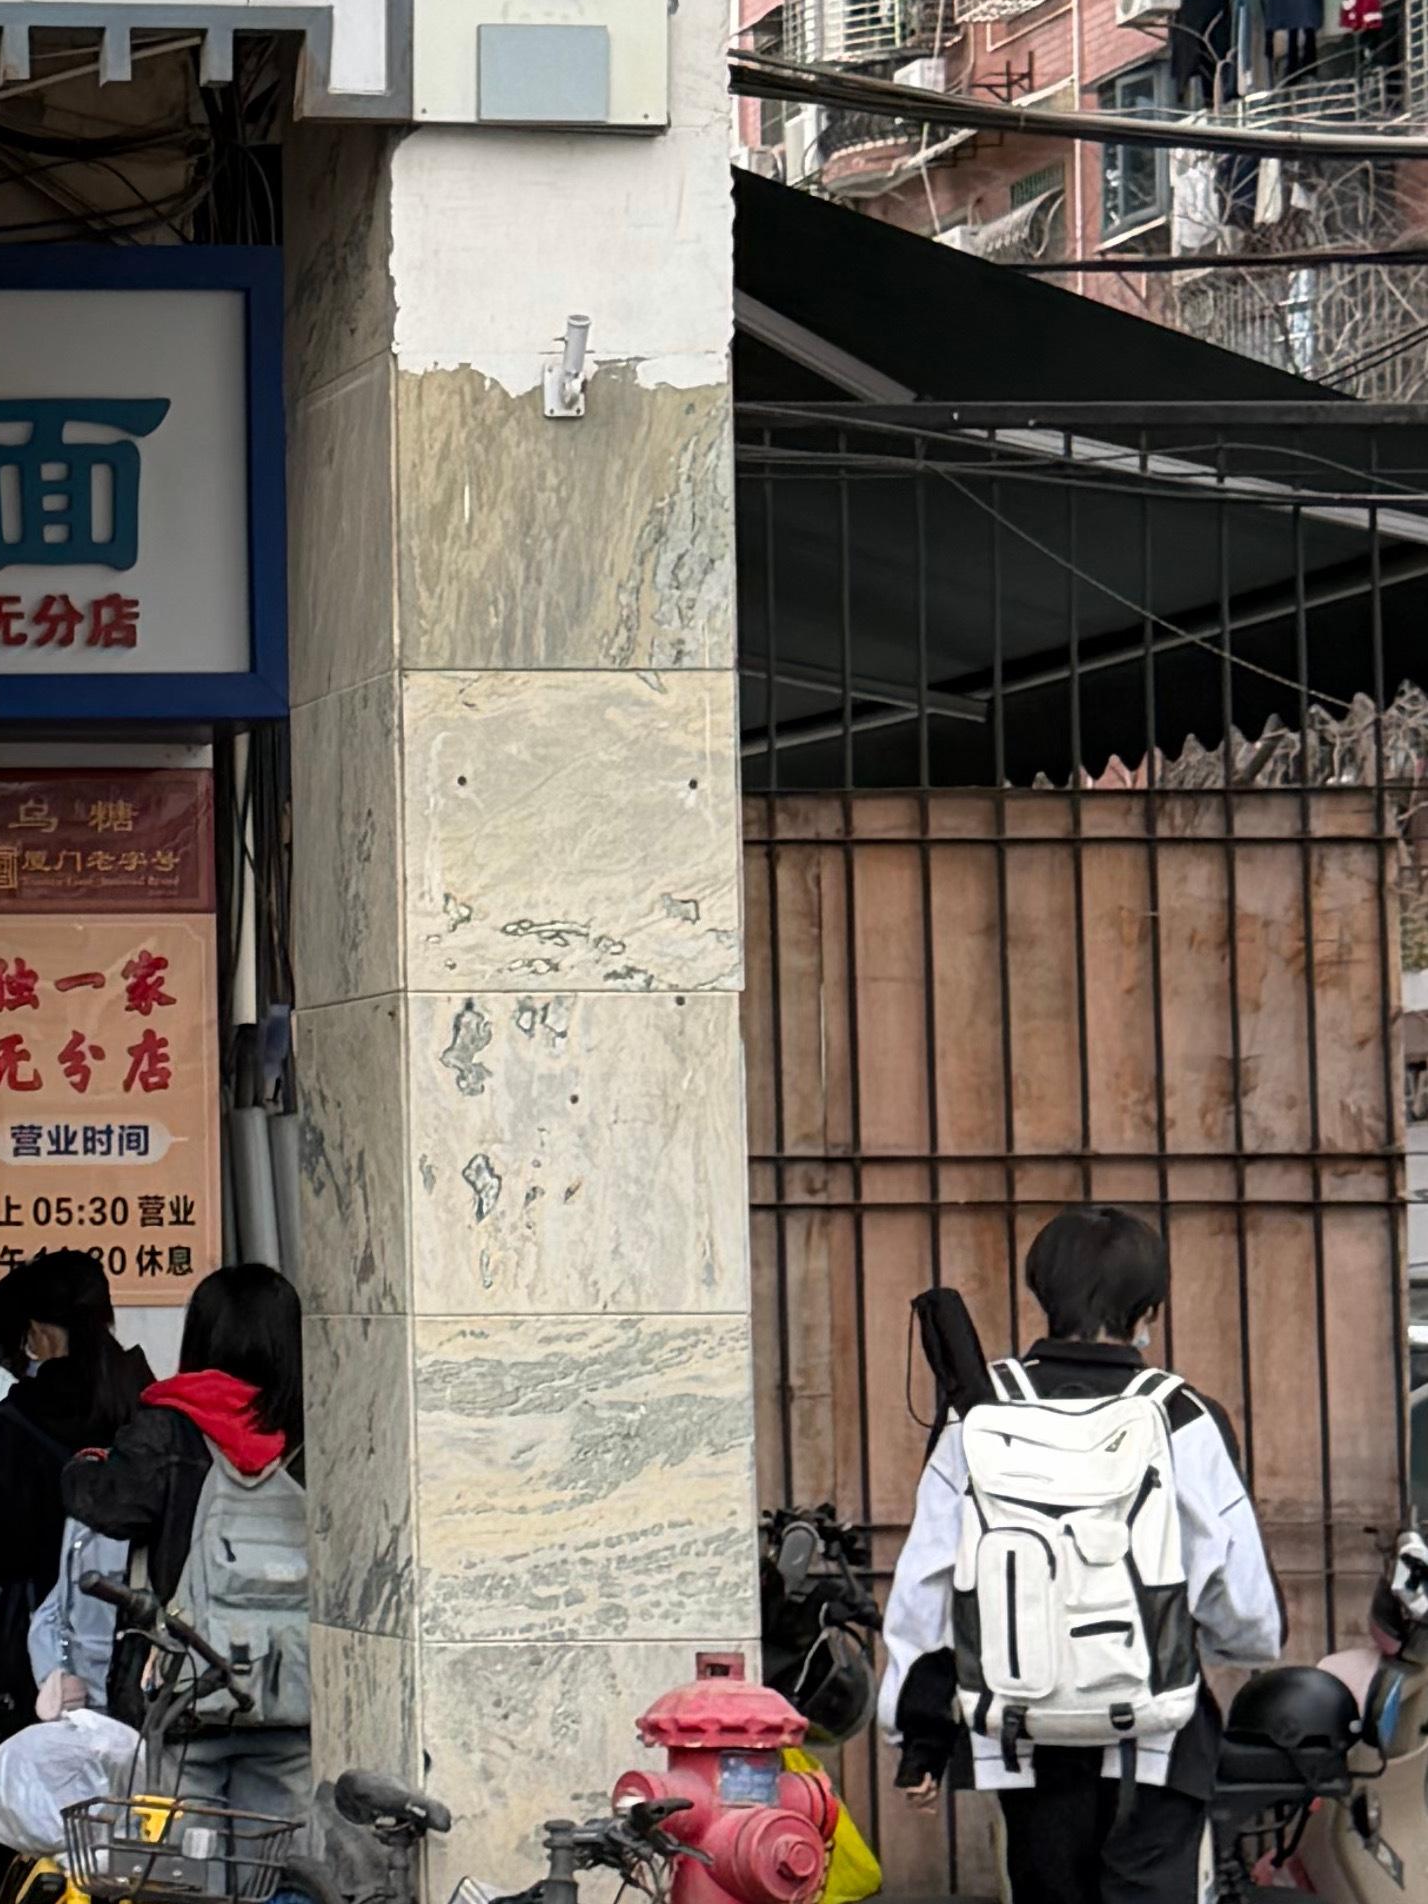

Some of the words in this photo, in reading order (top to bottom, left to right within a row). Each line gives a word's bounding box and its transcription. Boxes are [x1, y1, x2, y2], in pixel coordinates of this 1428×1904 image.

[8, 798, 138, 833] 乌糖
[21, 850, 181, 873] 厦门老字号
[10, 1124, 150, 1157] 营业时间
[33, 1197, 129, 1226] 05:30
[138, 1195, 196, 1228] 营业
[136, 1245, 194, 1277] 休息
